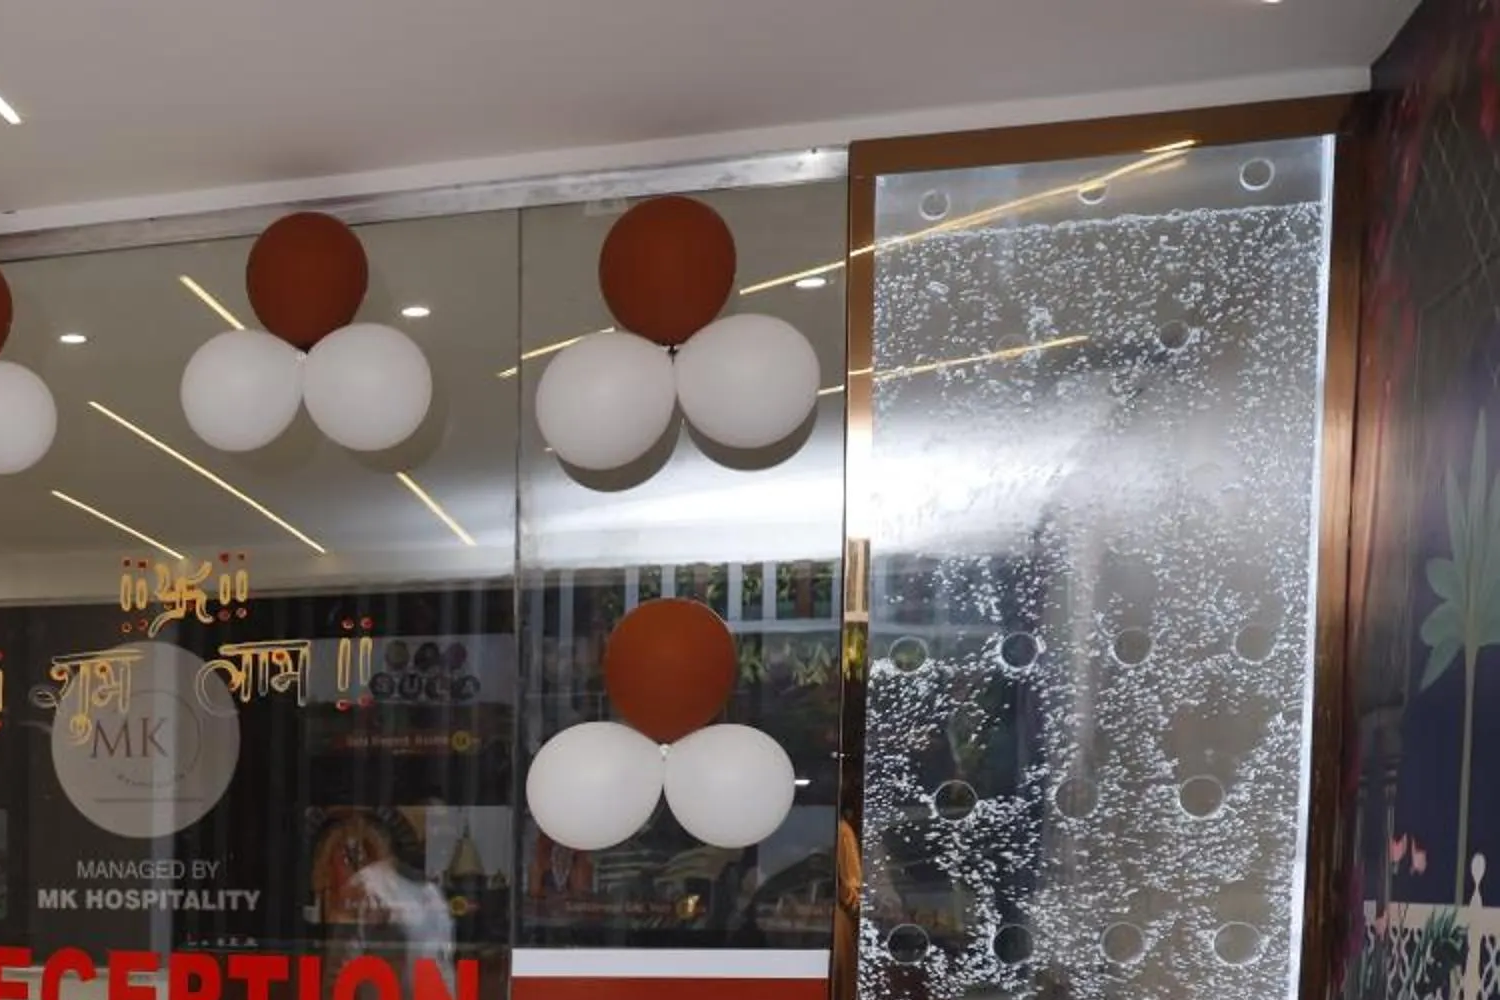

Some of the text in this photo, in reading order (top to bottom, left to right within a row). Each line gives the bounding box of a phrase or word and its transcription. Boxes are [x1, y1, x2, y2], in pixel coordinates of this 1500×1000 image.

[90, 716, 169, 760] MK
[76, 860, 221, 880] MANAGED BY
[36, 888, 262, 912] MK HOSPITALITY
